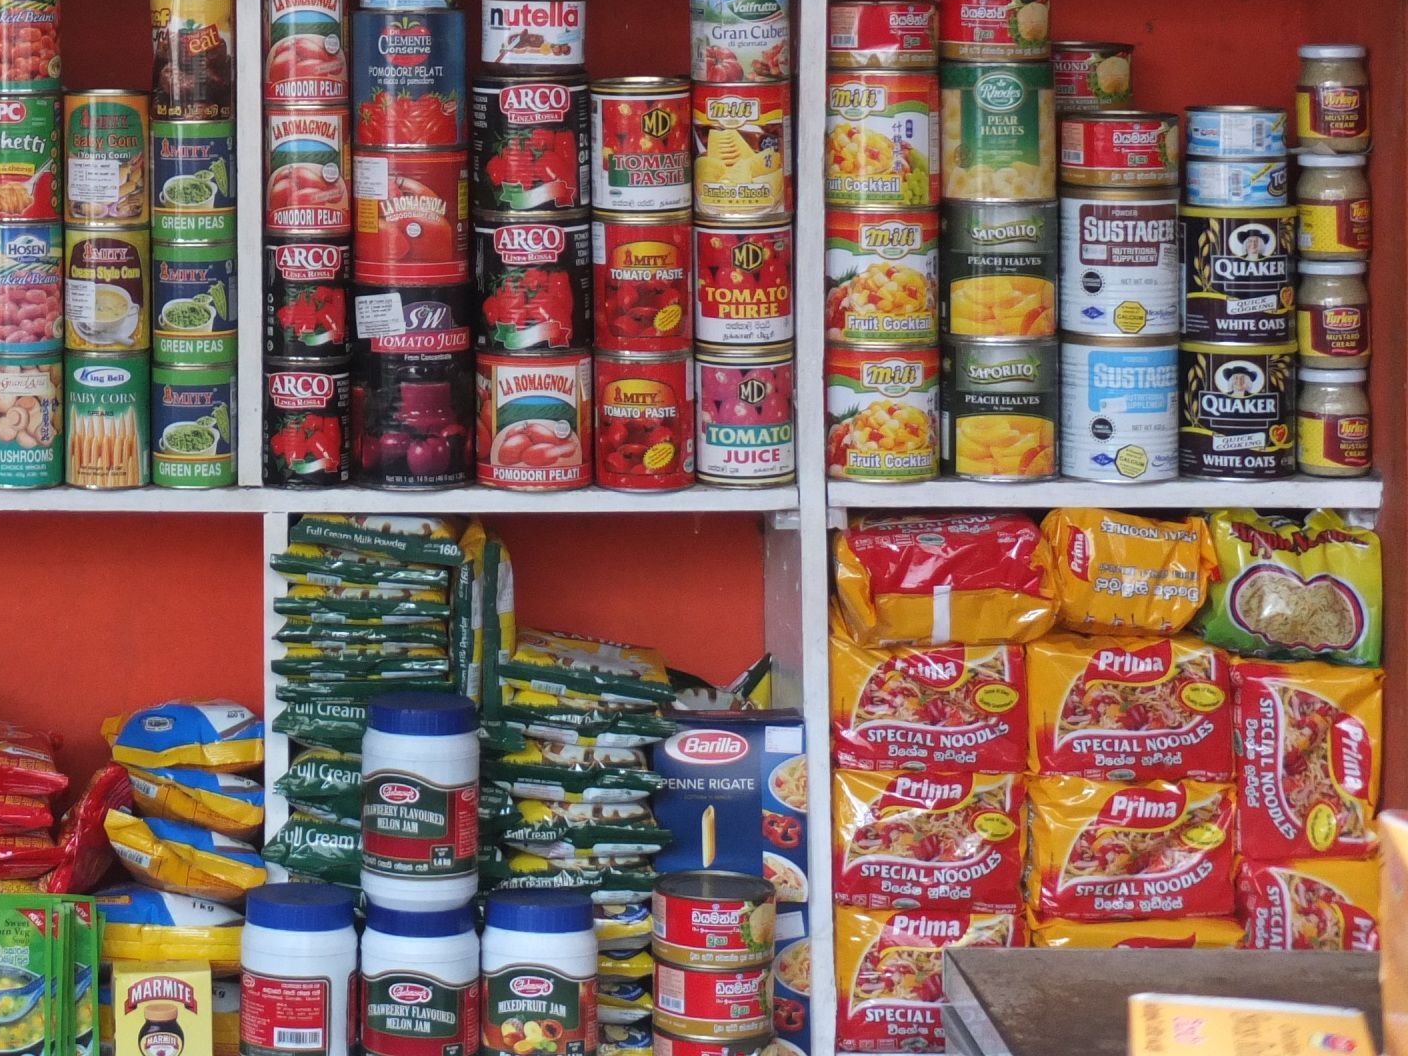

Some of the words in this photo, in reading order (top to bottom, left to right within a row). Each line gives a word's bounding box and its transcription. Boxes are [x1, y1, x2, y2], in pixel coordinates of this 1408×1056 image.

[491, 3, 579, 28] nutella
[505, 87, 567, 112] ARCO
[161, 215, 195, 229] GREEN
[199, 215, 224, 228] PEAS
[967, 256, 1001, 268] PEACH
[1004, 255, 1042, 267] HALVES
[1214, 259, 1285, 277] QUAKER
[611, 268, 652, 280] TOMATO
[656, 268, 683, 280] PASTE
[705, 287, 788, 304] TOMATO
[717, 304, 780, 318] PUREE
[847, 316, 882, 330] Fruit
[884, 315, 934, 330] Cocktail
[1217, 318, 1256, 330] WHITE
[1258, 318, 1284, 330] OATS
[272, 377, 331, 396] ARCO
[70, 392, 102, 403] BABY
[105, 392, 137, 403] CORN
[723, 448, 780, 464] JUICE
[493, 470, 546, 480] POMODORI
[549, 469, 580, 479] PELATI
[1098, 650, 1164, 673] Prima
[1073, 737, 1141, 753] SPECIAL
[1145, 719, 1215, 751] NOODLES
[684, 737, 741, 755] Barilla
[1342, 721, 1364, 791] Prima
[661, 777, 698, 790] PENNE
[702, 777, 755, 790] RIGATE
[1110, 796, 1177, 818] Prima
[128, 982, 193, 1004] MARMITE
